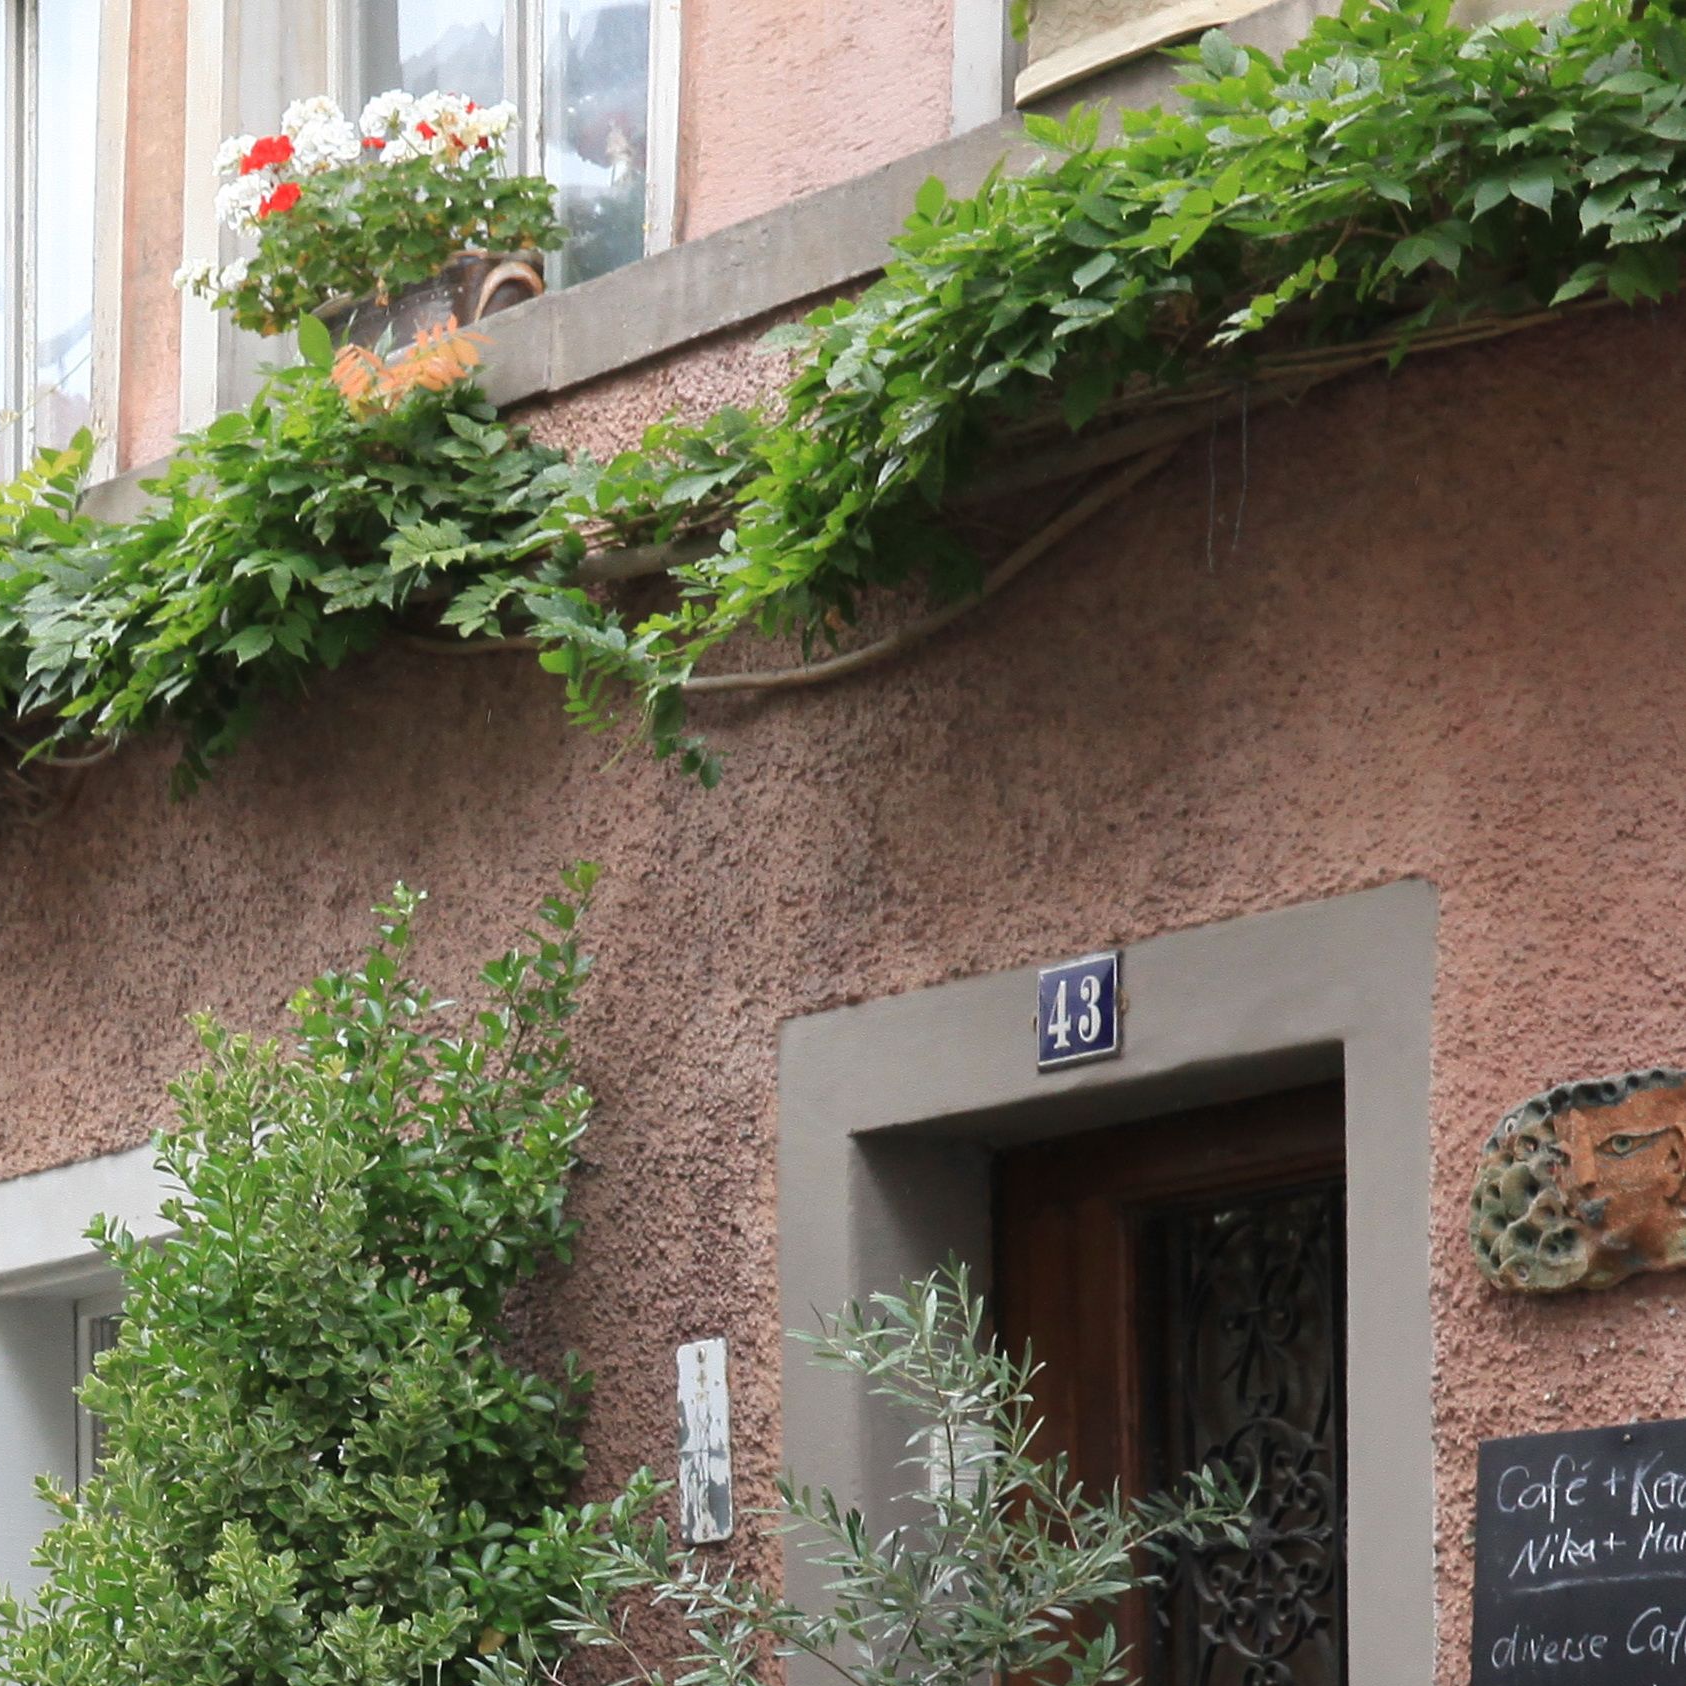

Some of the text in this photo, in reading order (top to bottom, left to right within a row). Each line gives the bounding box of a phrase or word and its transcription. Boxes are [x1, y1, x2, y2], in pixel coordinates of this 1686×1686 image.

[1048, 975, 1101, 1049] 43
[1497, 1454, 1593, 1523] Café
[1508, 1527, 1596, 1579] Nika
[1491, 1606, 1686, 1669] diverse Caf
